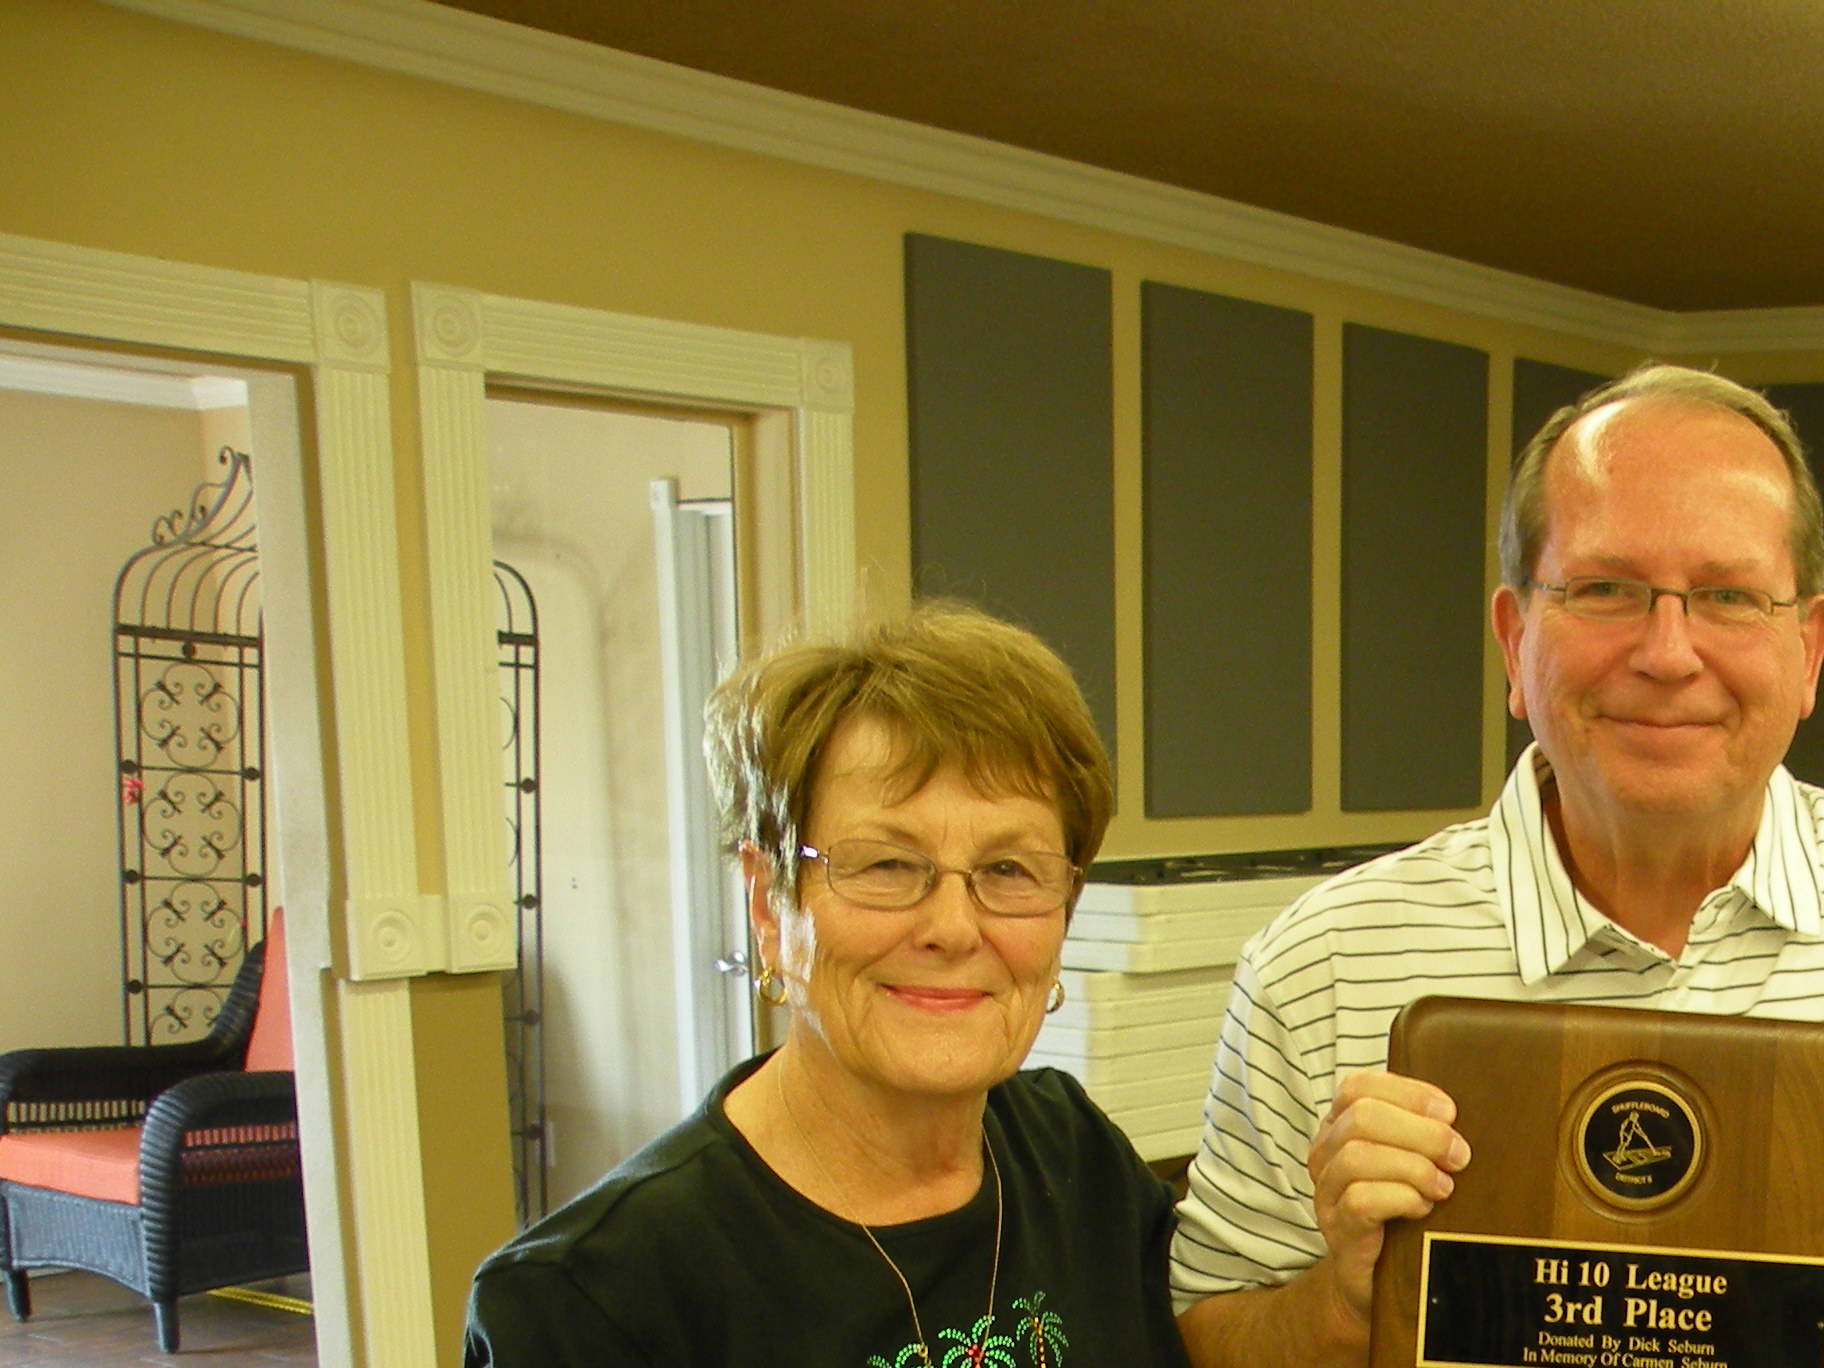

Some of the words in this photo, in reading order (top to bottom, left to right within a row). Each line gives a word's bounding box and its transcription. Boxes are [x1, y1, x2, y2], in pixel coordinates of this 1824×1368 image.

[1535, 1258, 1569, 1286] Hi
[1578, 1261, 1610, 1288] 10
[1625, 1264, 1728, 1299] League
[1543, 1292, 1603, 1326] 3rd
[1623, 1297, 1713, 1332] Place
[1523, 1347, 1537, 1362] In
[1541, 1348, 1597, 1368] Memory
[1600, 1351, 1621, 1367] Of
[1538, 1331, 1595, 1348] Donated
[1602, 1335, 1622, 1353] By
[1628, 1336, 1661, 1353] Dick
